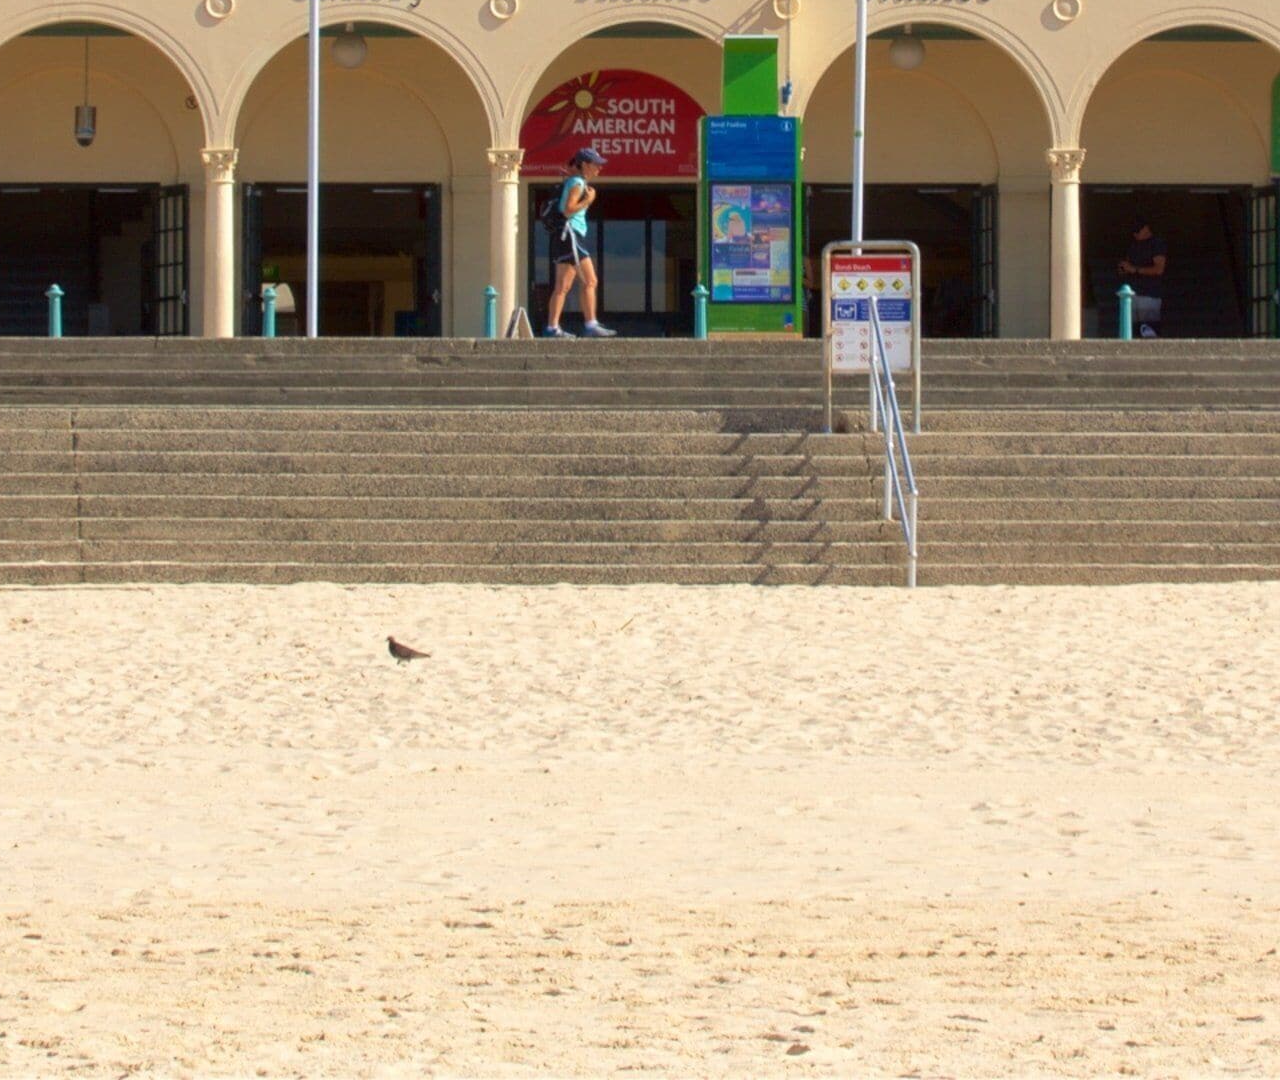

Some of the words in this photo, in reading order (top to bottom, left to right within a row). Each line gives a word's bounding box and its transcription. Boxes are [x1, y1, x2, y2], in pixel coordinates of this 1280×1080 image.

[607, 98, 676, 115] SOUTH
[572, 119, 676, 135] AMERICAN
[591, 138, 677, 155] FESTIVAL
